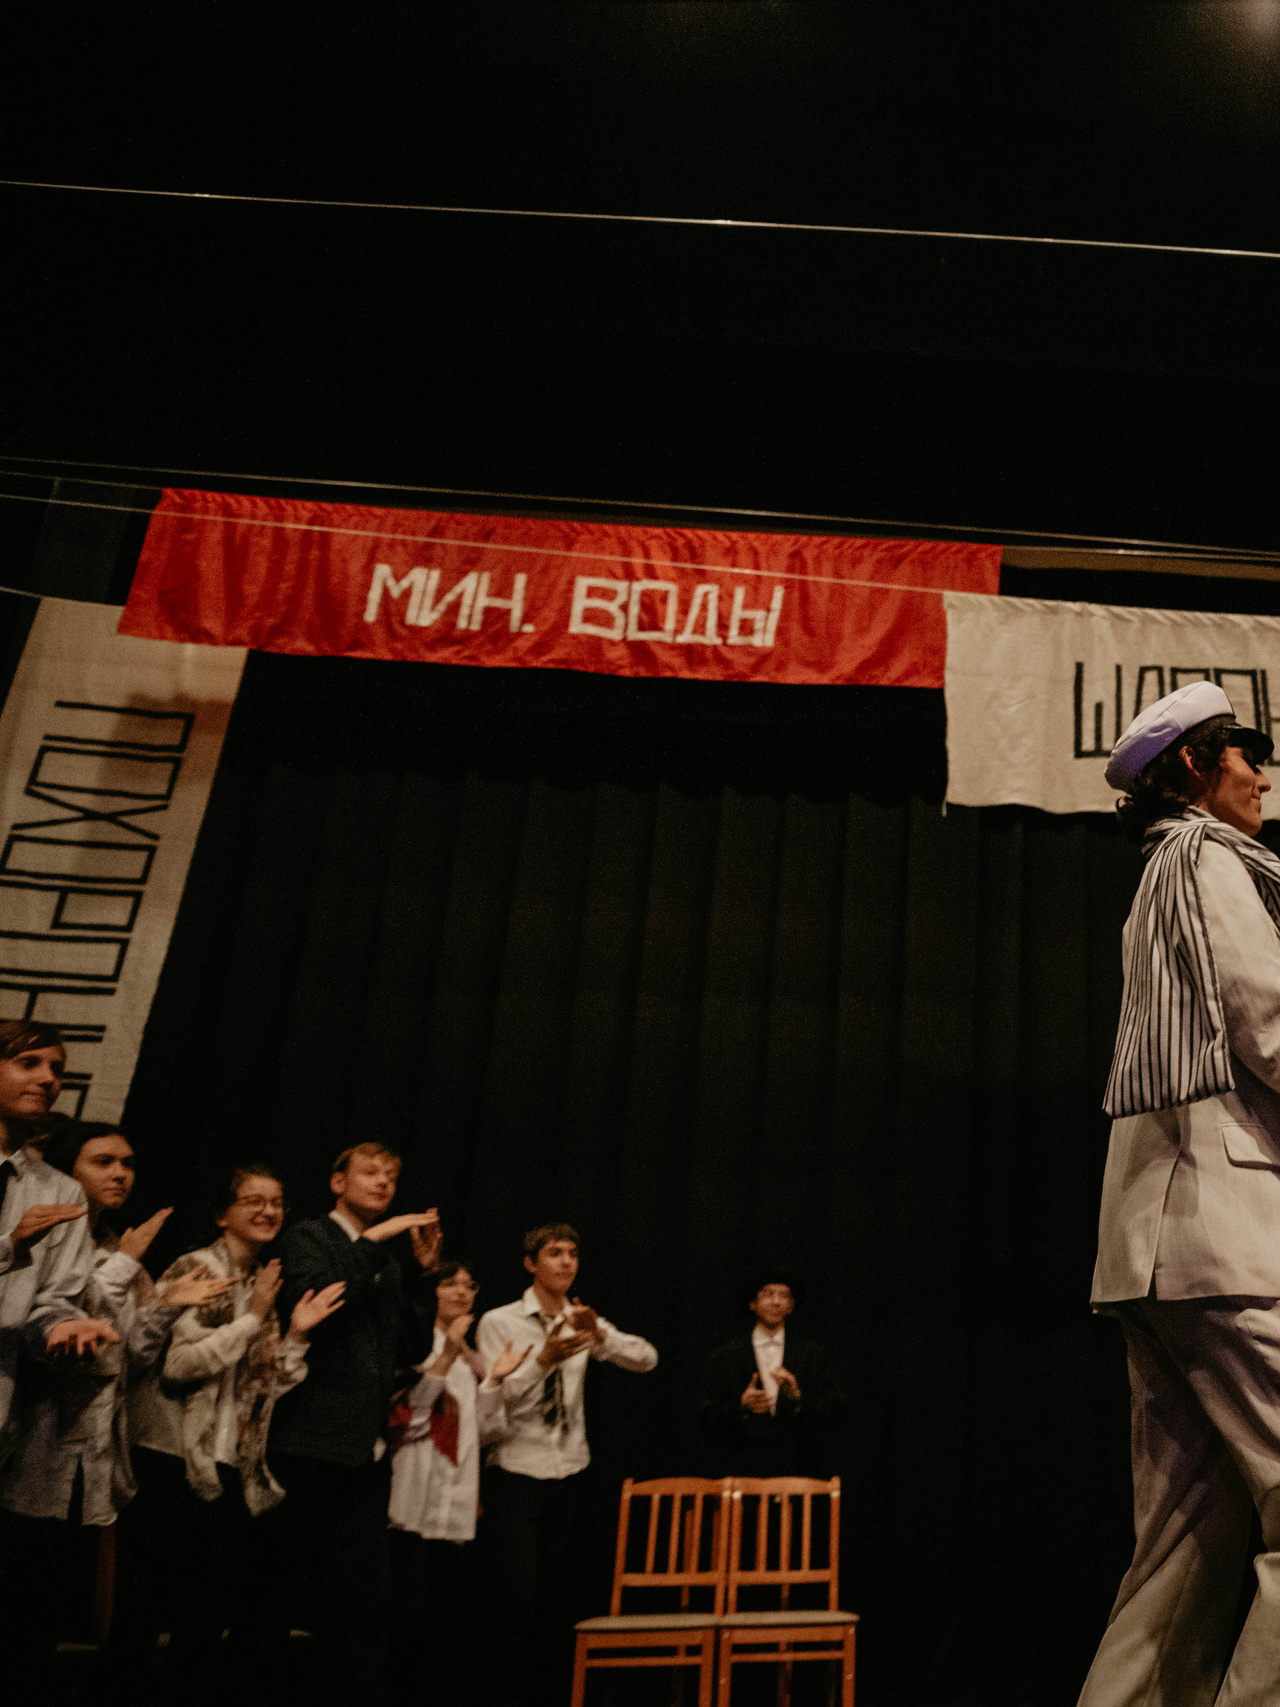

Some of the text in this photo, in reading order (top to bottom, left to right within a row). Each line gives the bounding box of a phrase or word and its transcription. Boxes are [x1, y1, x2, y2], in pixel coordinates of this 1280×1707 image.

[362, 562, 786, 648] МИН. ВОДЫ
[0, 700, 196, 1121] ПОХОРОН
